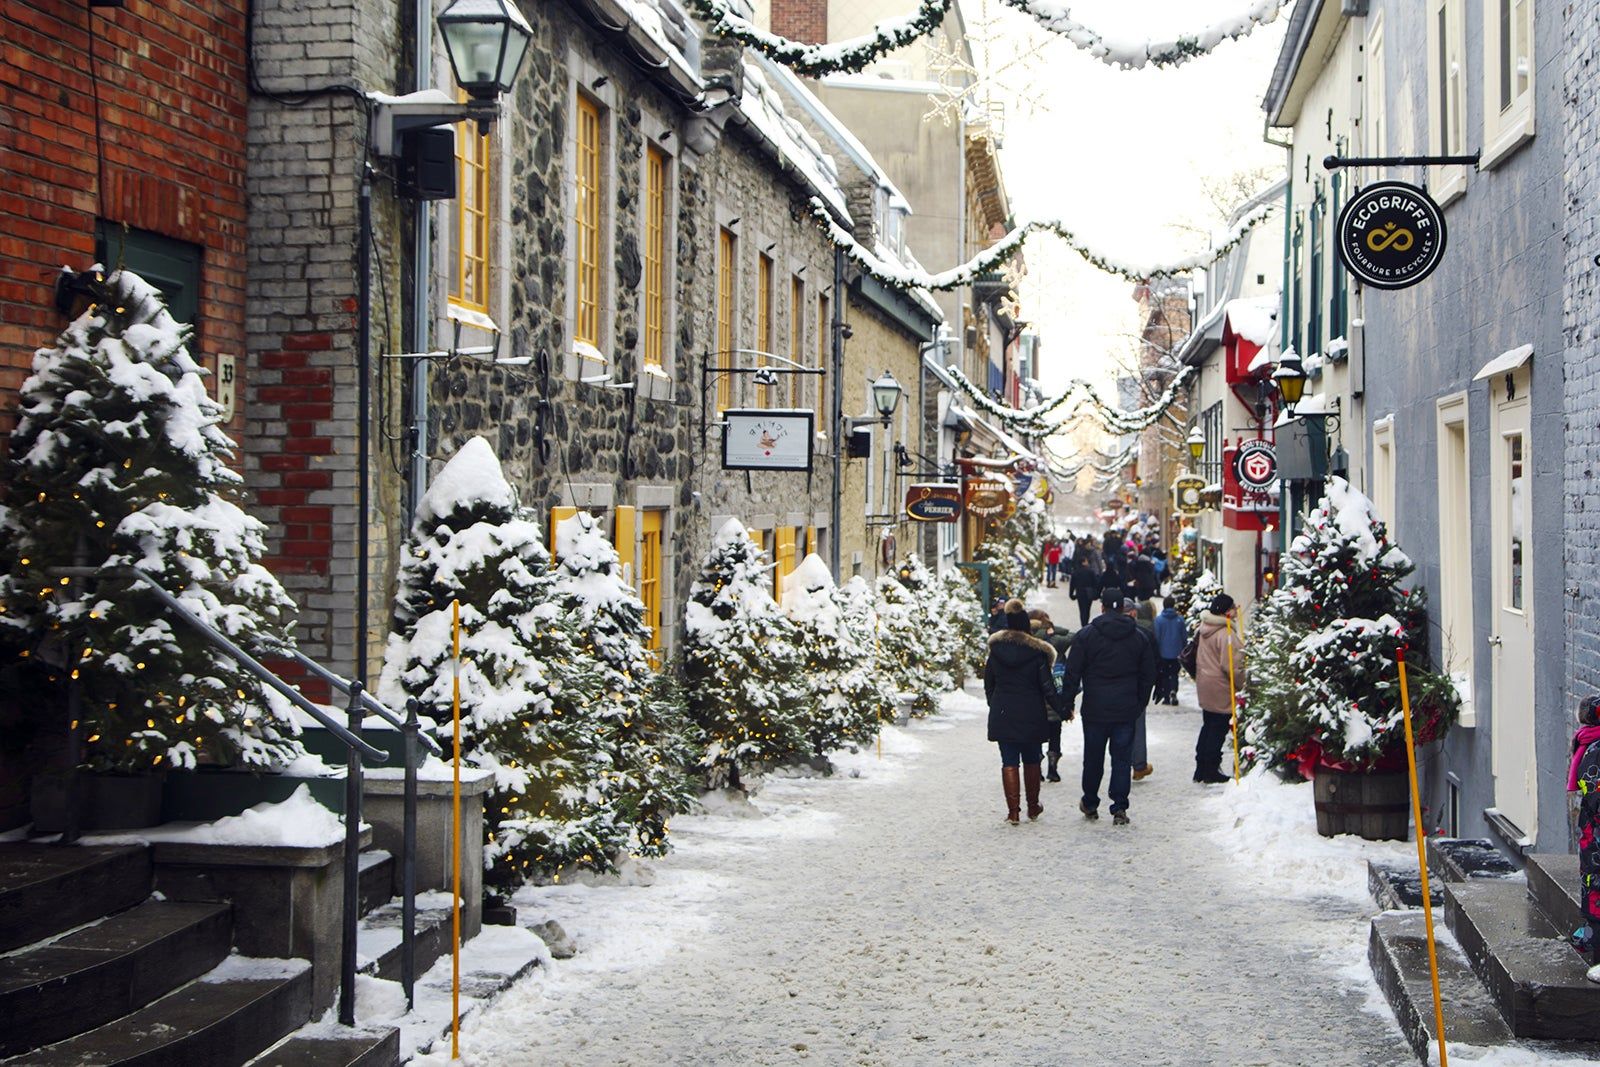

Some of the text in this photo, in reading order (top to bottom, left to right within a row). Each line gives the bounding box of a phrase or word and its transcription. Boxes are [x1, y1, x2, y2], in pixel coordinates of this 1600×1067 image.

[1352, 196, 1430, 230] ECOGRIFFE
[1351, 242, 1391, 276] FOURRURE
[924, 506, 954, 517] PERRIER
